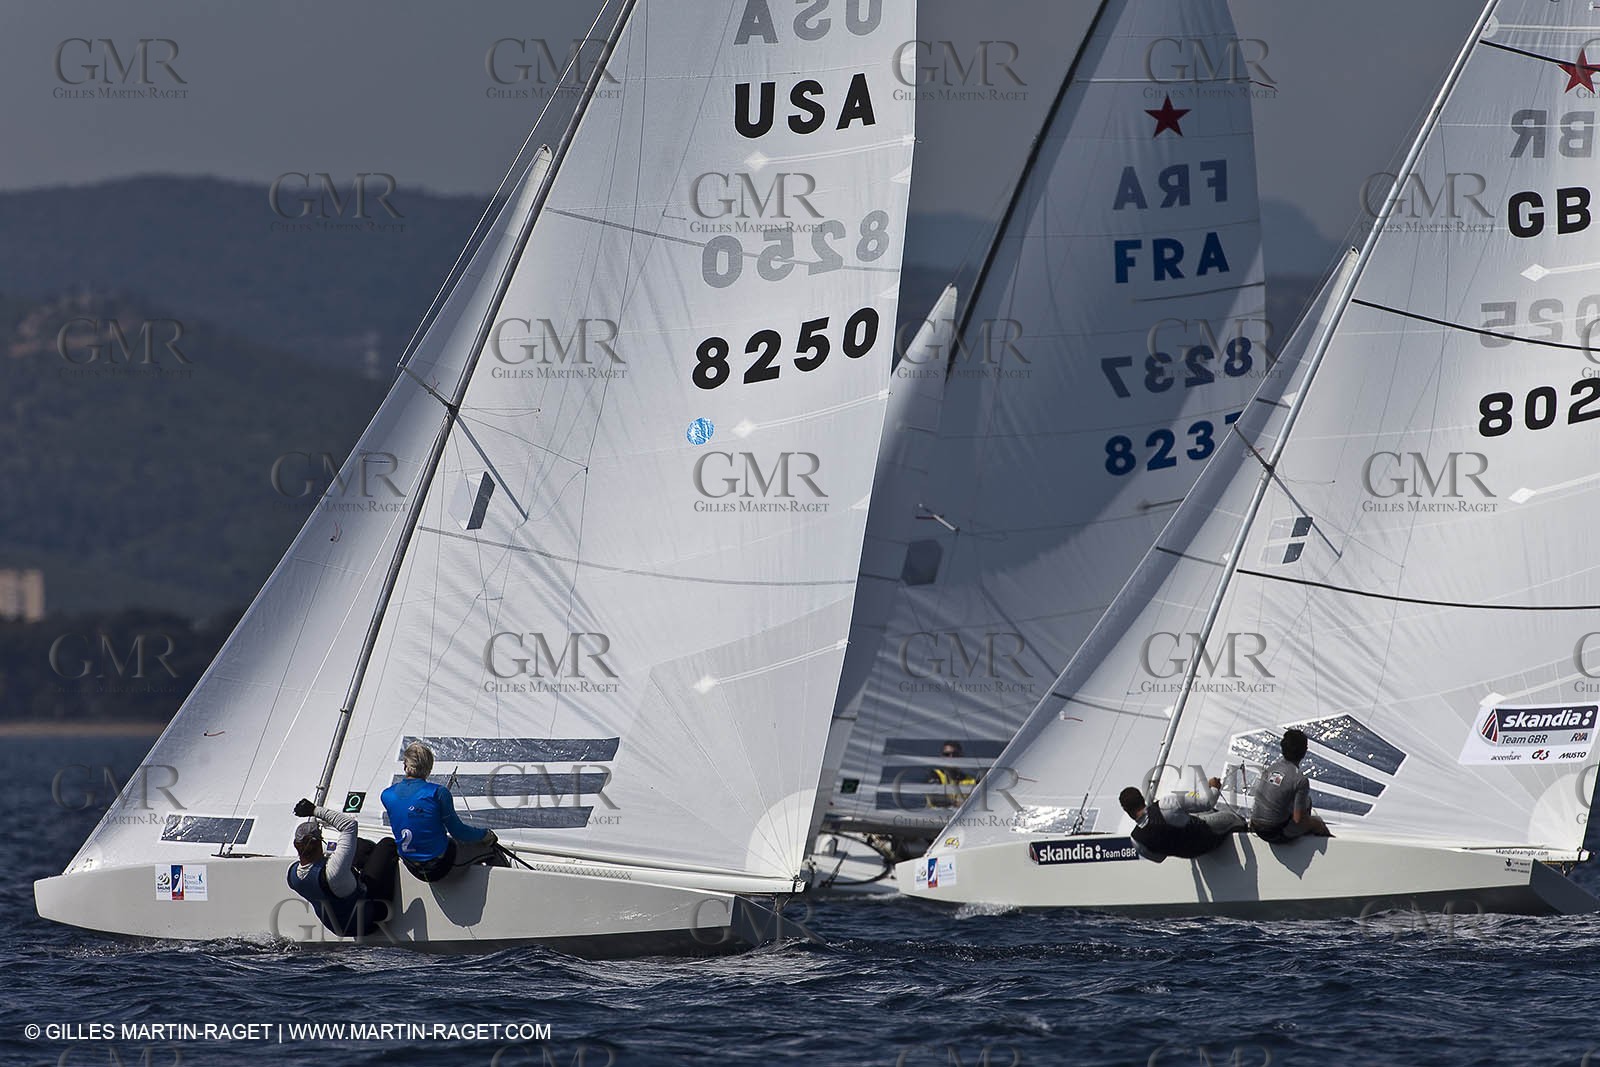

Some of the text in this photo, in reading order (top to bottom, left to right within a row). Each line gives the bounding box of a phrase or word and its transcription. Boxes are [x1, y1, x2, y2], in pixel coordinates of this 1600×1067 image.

[734, 73, 876, 139] USA
[1113, 231, 1230, 284] FRA
[691, 307, 880, 390] 8250
[1501, 733, 1548, 745] Team GBR
[1558, 751, 1587, 760] MUSTO
[1102, 849, 1120, 859] Team
[1121, 847, 1137, 858] GBR
